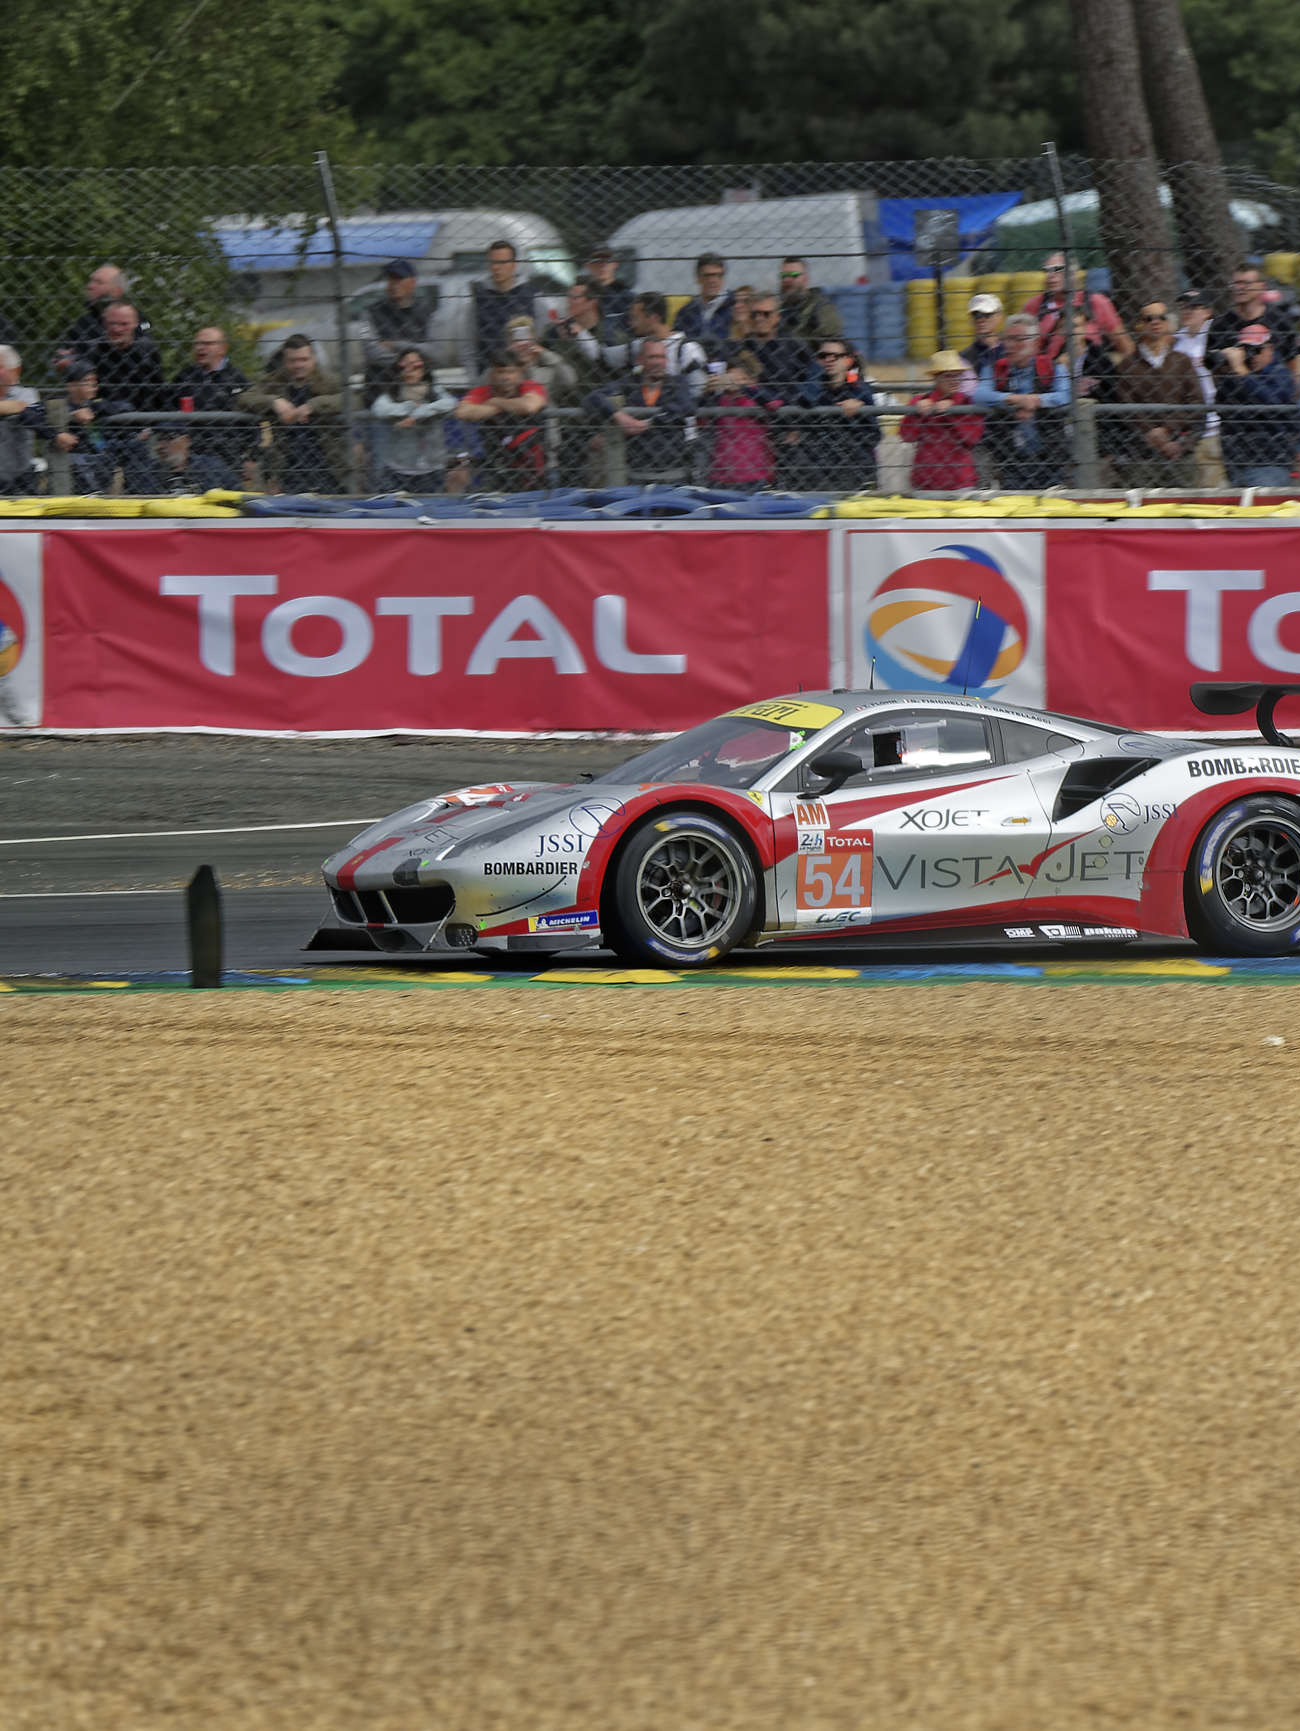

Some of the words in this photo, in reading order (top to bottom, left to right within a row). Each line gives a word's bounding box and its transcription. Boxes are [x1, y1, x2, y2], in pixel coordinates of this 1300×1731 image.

[160, 574, 687, 677] TOTAL
[796, 803, 827, 825] AM
[1143, 803, 1179, 824] JSSI
[536, 834, 585, 857] JSSI
[826, 836, 871, 848] TOTAL
[484, 862, 578, 875] BOMBARDIER
[804, 854, 864, 907] 54
[548, 916, 591, 926] MICHELIN
